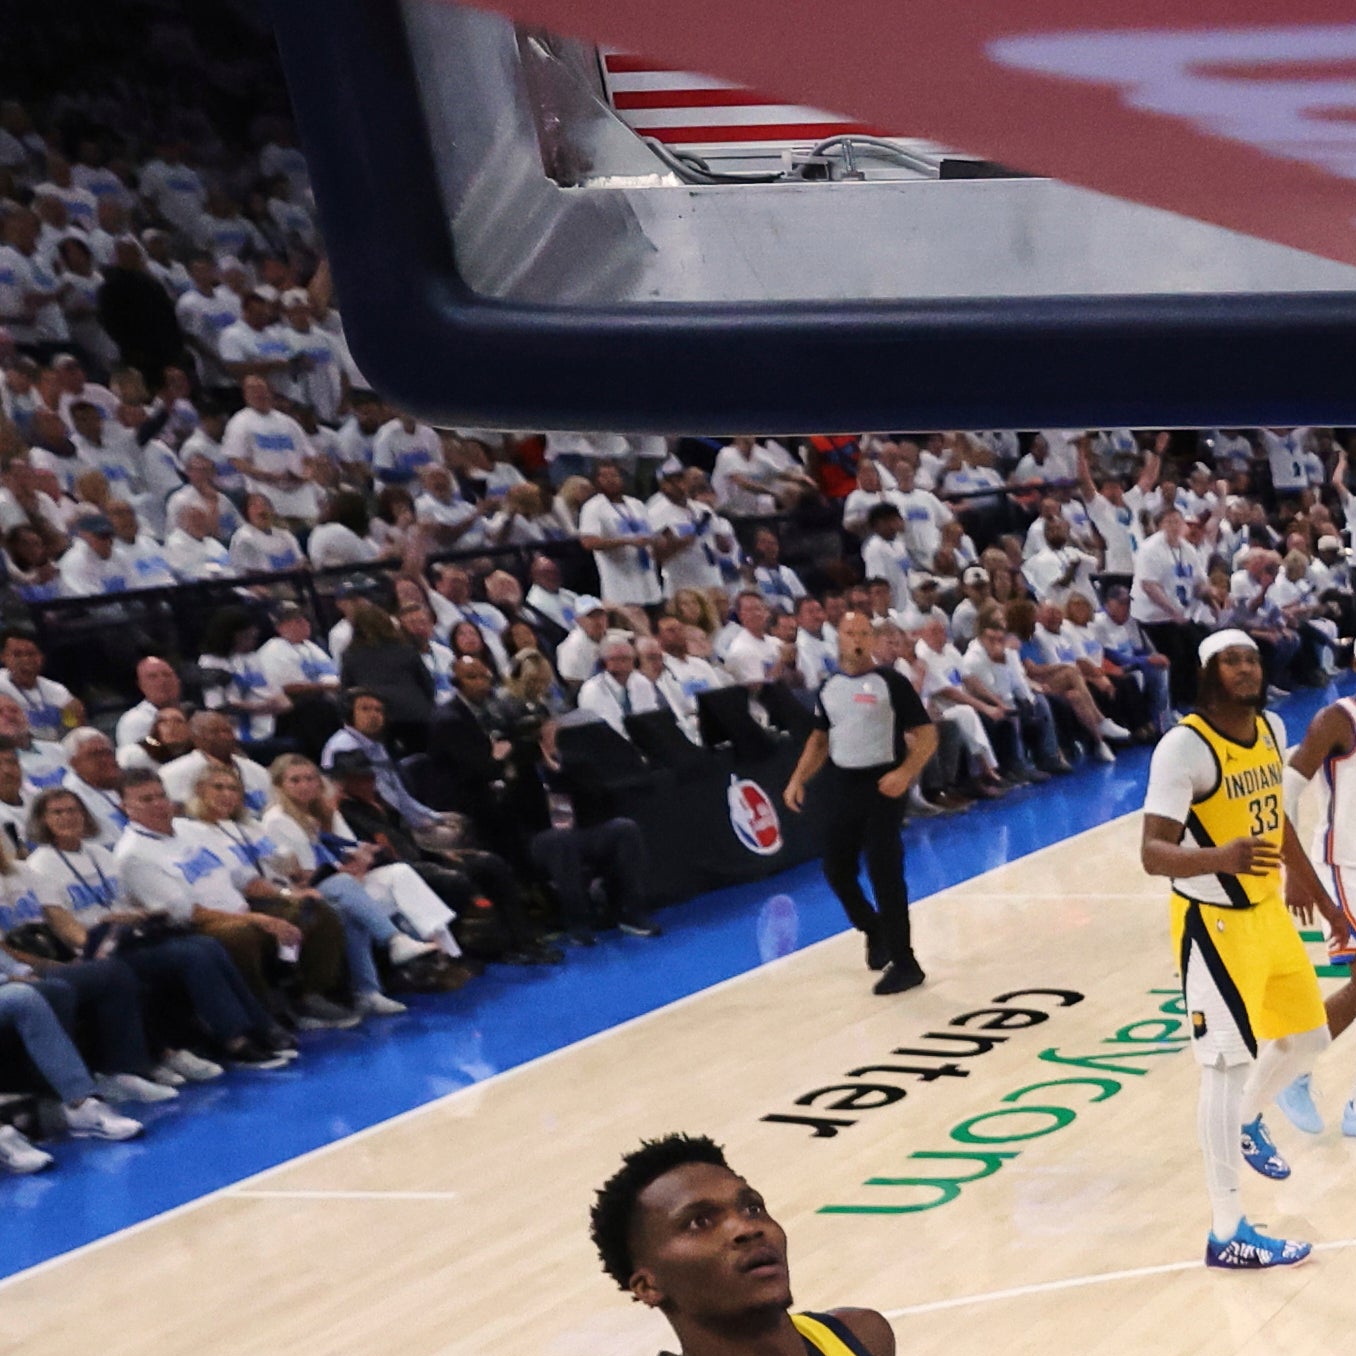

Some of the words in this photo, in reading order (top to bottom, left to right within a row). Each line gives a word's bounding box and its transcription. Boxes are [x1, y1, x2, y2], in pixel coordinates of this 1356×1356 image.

[1225, 761, 1283, 799] INDIAN
[1248, 794, 1279, 837] 33
[760, 987, 1085, 1138] center
